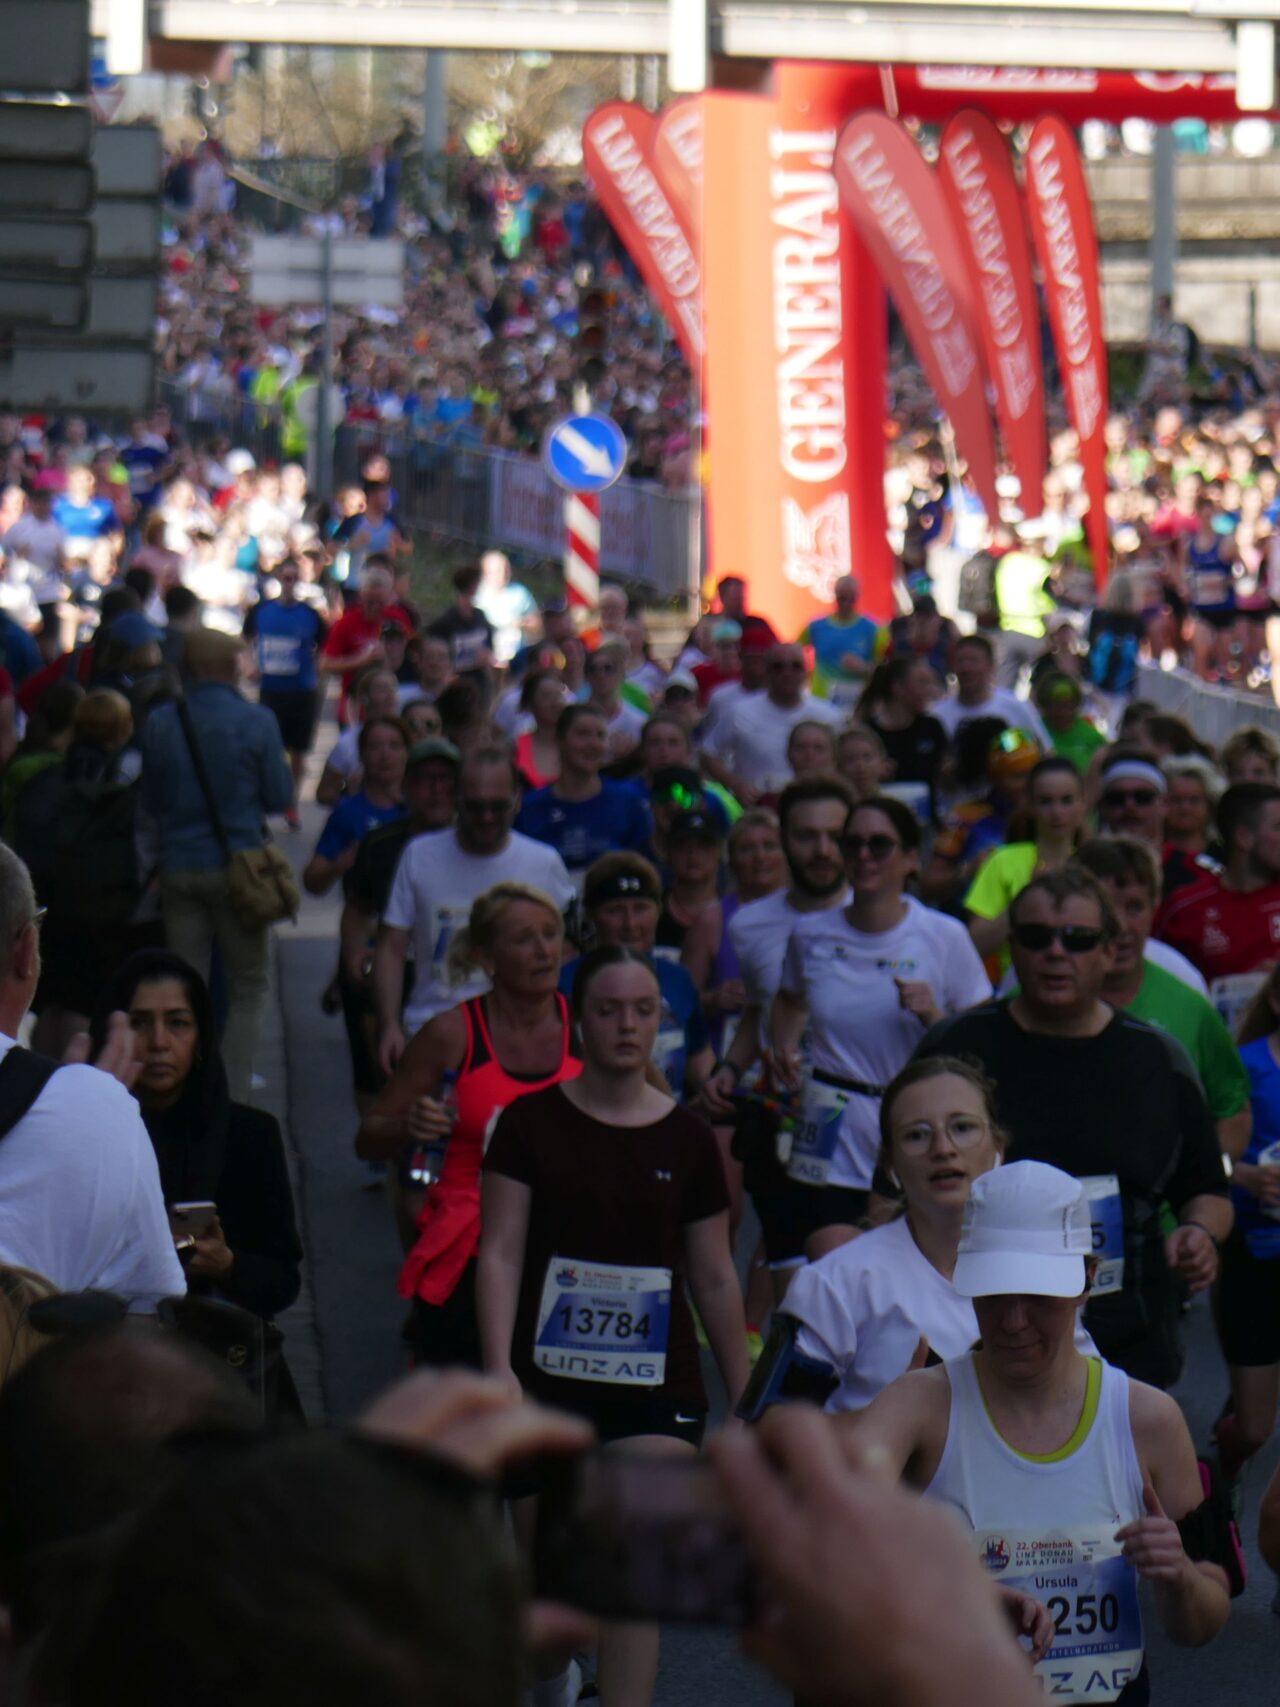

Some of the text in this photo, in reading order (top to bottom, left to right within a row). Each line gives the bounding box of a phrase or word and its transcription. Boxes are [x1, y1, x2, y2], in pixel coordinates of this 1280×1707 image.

[768, 129, 848, 484] GENERALI
[560, 1305, 651, 1340] 13784
[614, 1362, 656, 1379] AG
[1031, 1539, 1073, 1550] Oberbank
[1039, 1549, 1074, 1558] DONAU
[1015, 1557, 1074, 1567] MARATHON
[1035, 1575, 1079, 1590] Ursula
[1046, 1593, 1120, 1636] 250
